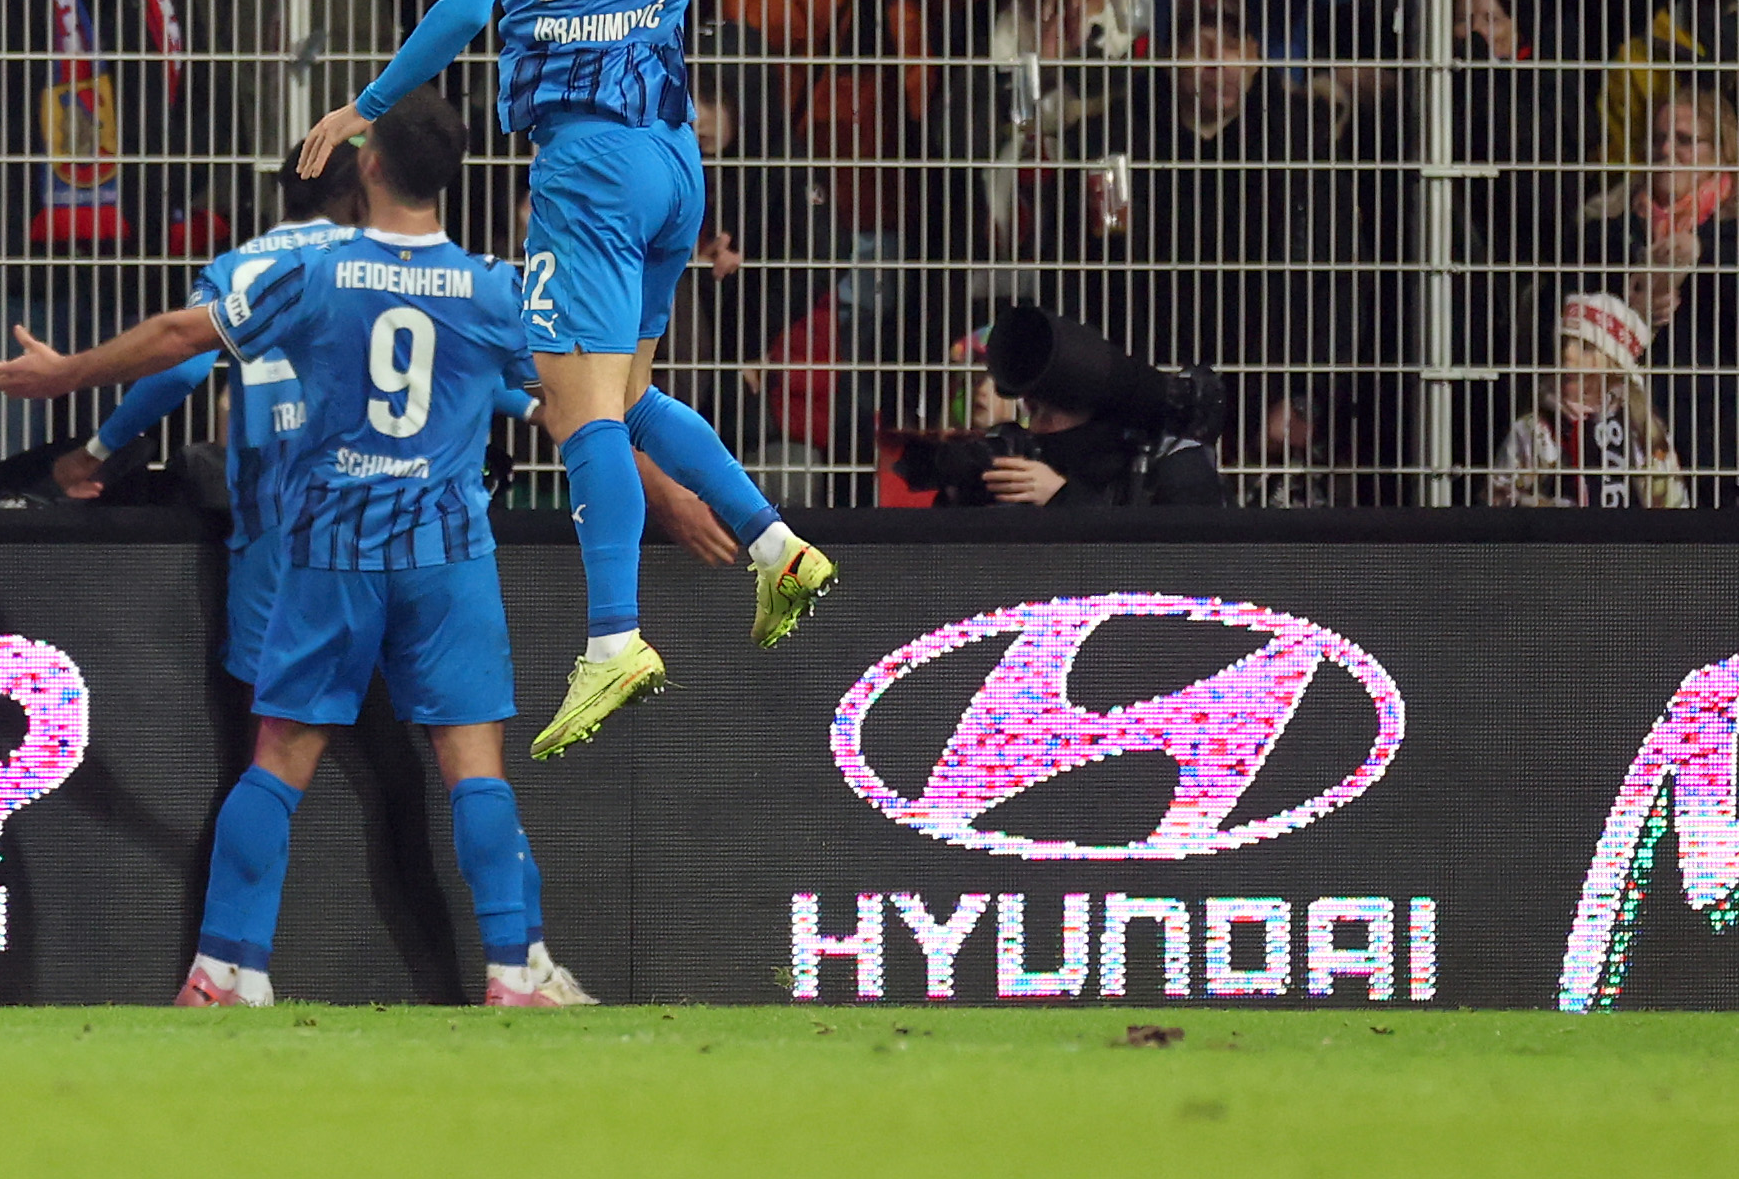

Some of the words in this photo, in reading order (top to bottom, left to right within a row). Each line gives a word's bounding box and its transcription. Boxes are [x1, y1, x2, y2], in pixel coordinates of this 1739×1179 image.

[336, 261, 474, 300] HEIDENHEIM
[522, 251, 556, 311] 2
[367, 306, 436, 438] 9
[791, 892, 1437, 1001] HYUNDAI
